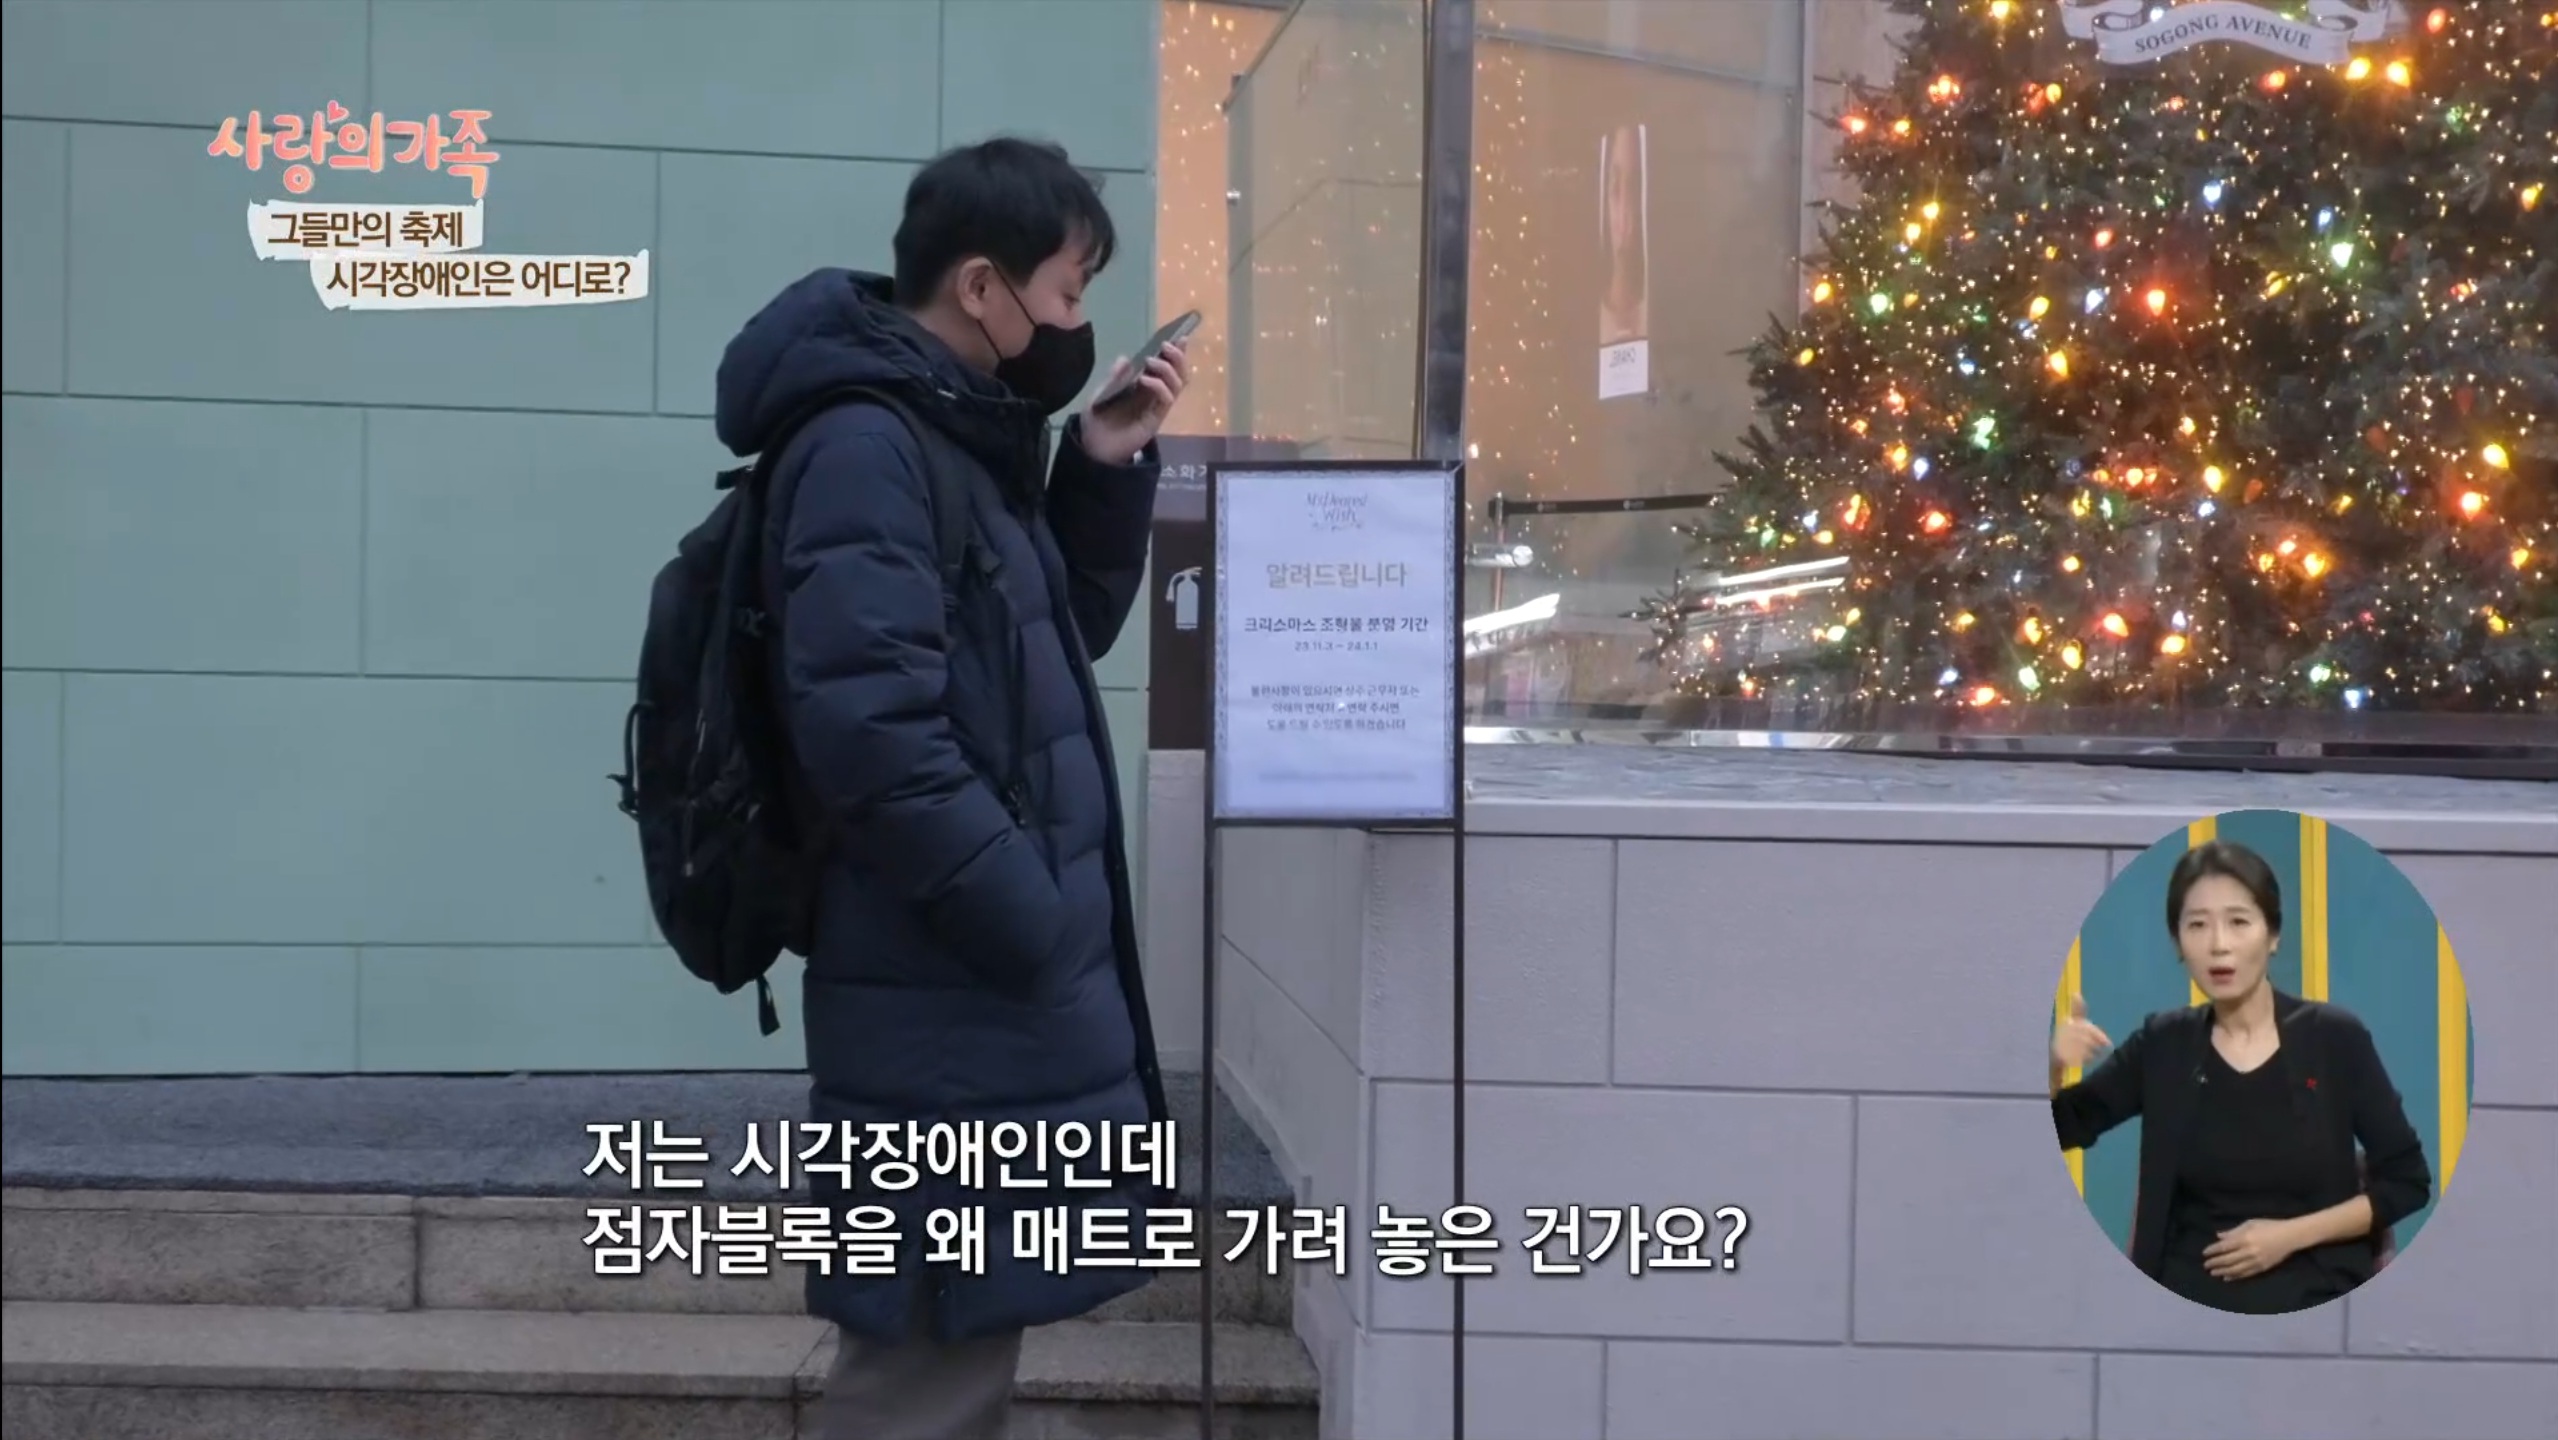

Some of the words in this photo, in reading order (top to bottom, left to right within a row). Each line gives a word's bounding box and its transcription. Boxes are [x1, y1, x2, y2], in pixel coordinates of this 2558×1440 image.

[2135, 15, 2219, 53] SOGONG
[2226, 16, 2312, 49] AVENUE
[1266, 562, 1407, 589] 알려드립니다
[1244, 617, 1316, 632] 크리스마스
[1401, 617, 1428, 632] 기간
